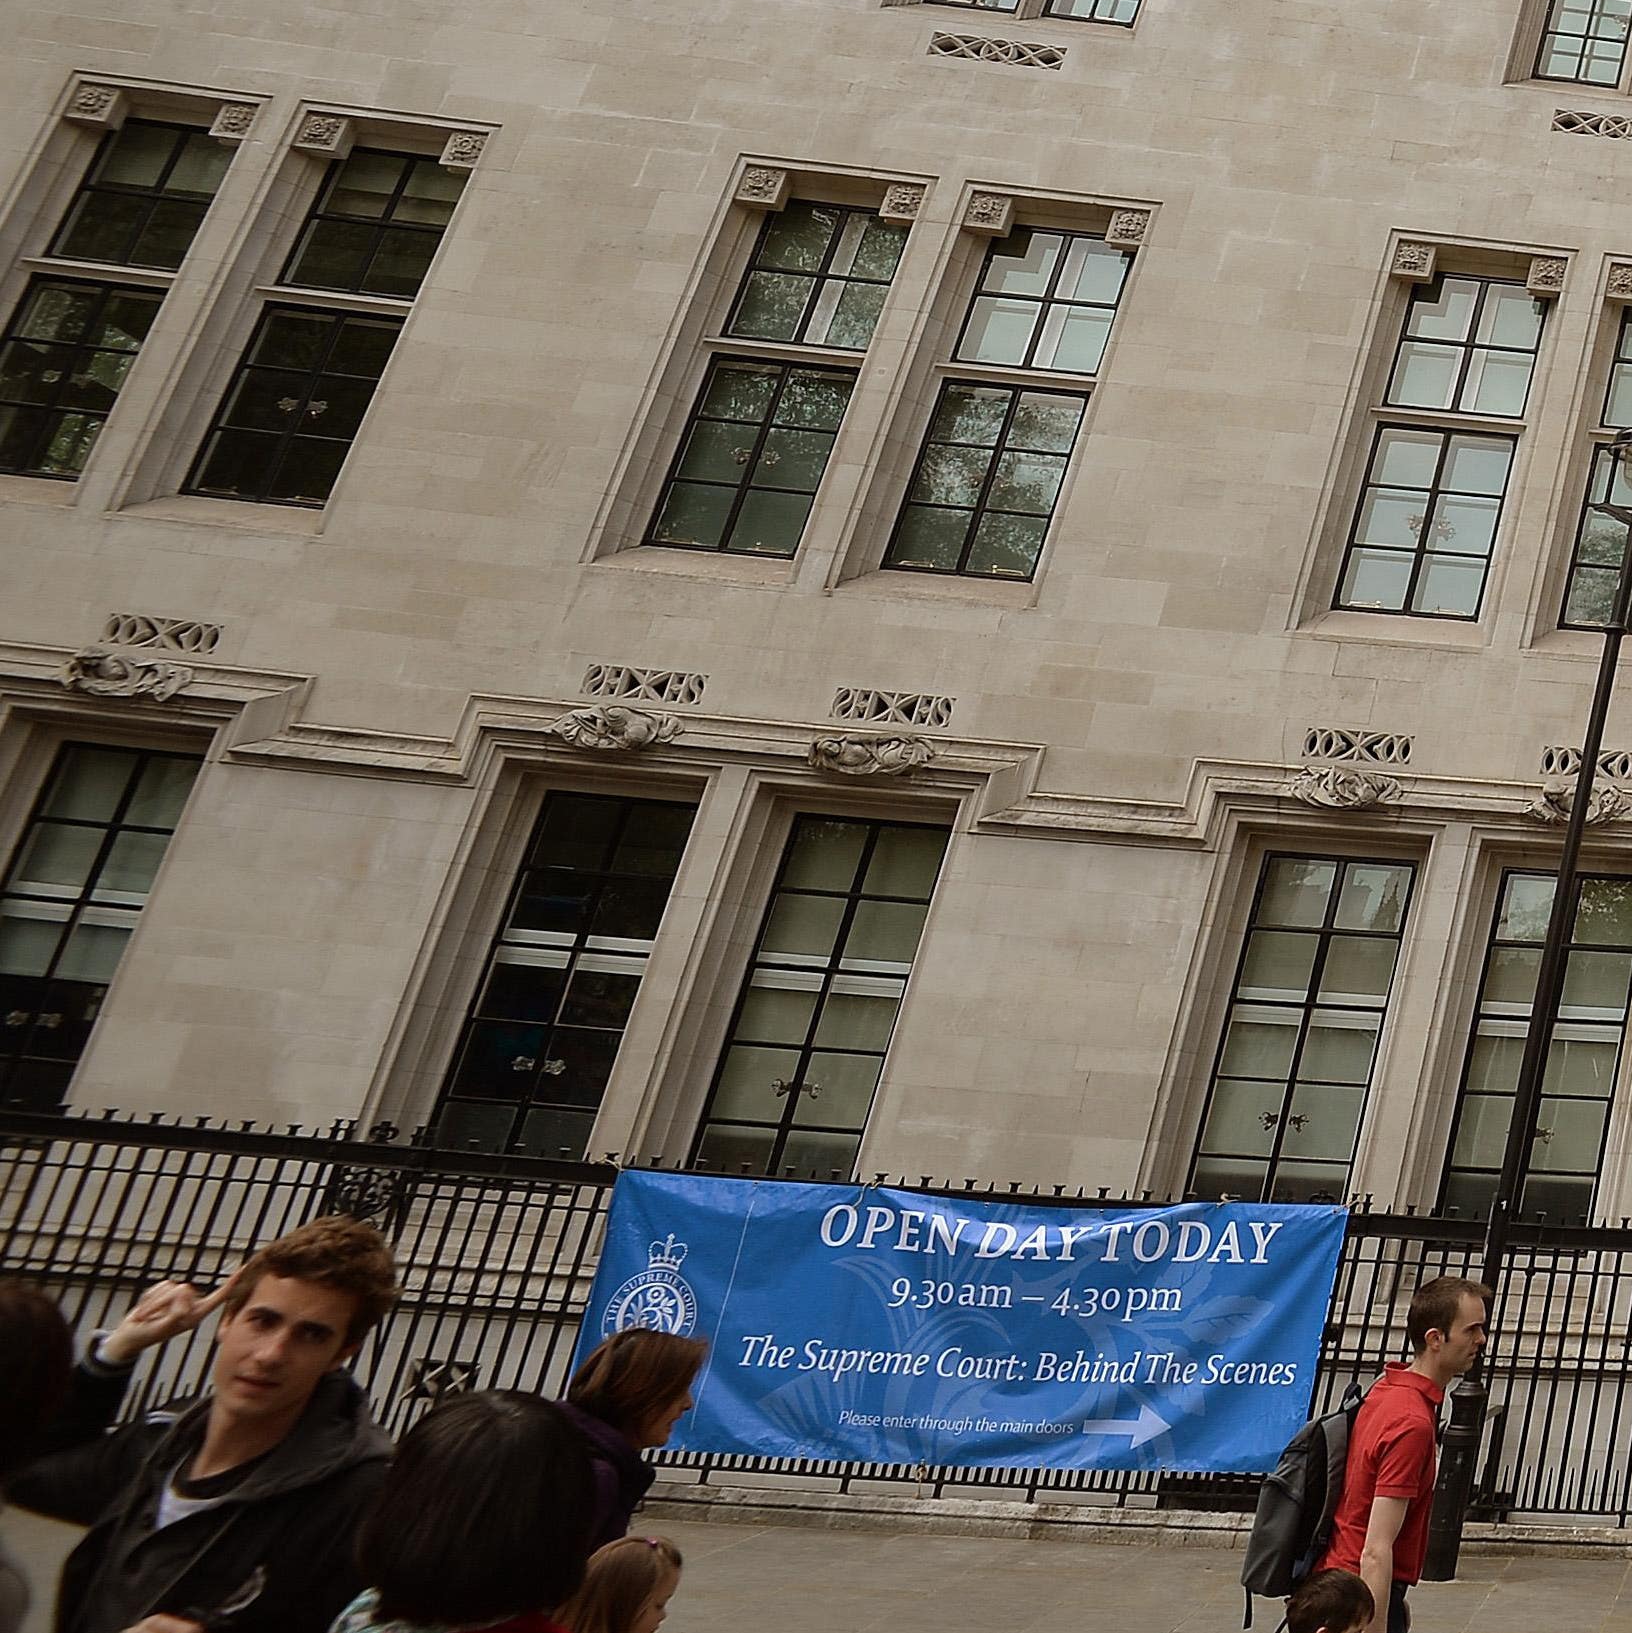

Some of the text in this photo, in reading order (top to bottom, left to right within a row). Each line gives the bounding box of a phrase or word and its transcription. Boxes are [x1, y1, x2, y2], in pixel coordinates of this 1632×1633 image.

[820, 1204, 1283, 1264] OPEN DAY TODAY
[606, 1272, 694, 1327] THE SUPREME COURT
[738, 1334, 1297, 1386] The Supreme Court: Behind The Scenes
[838, 1410, 1074, 1436] Please enter through the main doors
